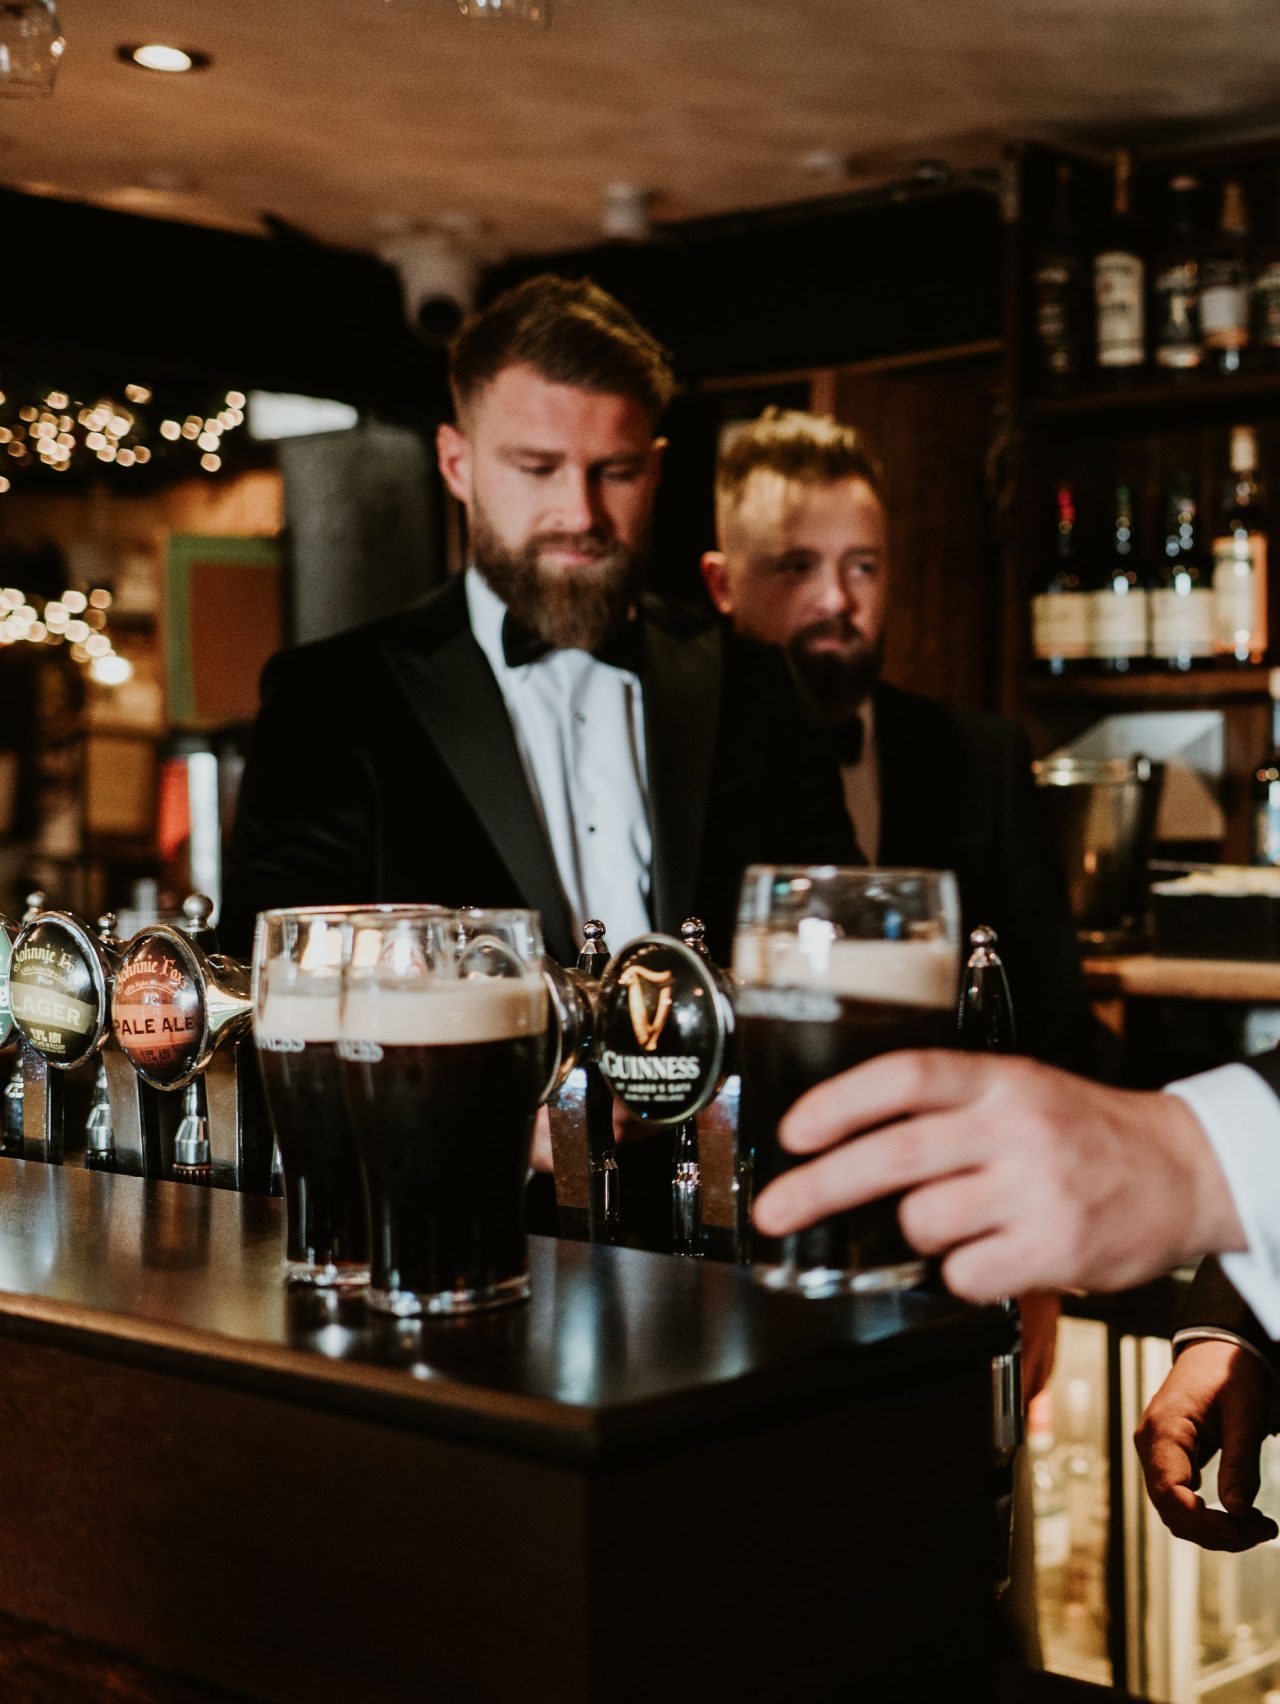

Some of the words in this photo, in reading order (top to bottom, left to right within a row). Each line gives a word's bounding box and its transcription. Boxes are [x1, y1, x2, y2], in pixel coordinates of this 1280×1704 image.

[13, 943, 56, 972] Johnnie
[116, 955, 158, 994] Johnnie
[11, 992, 80, 1026] LAGER
[113, 1018, 156, 1035] PALE
[162, 1016, 195, 1033] ALE
[601, 1050, 700, 1079] GUINNESS
